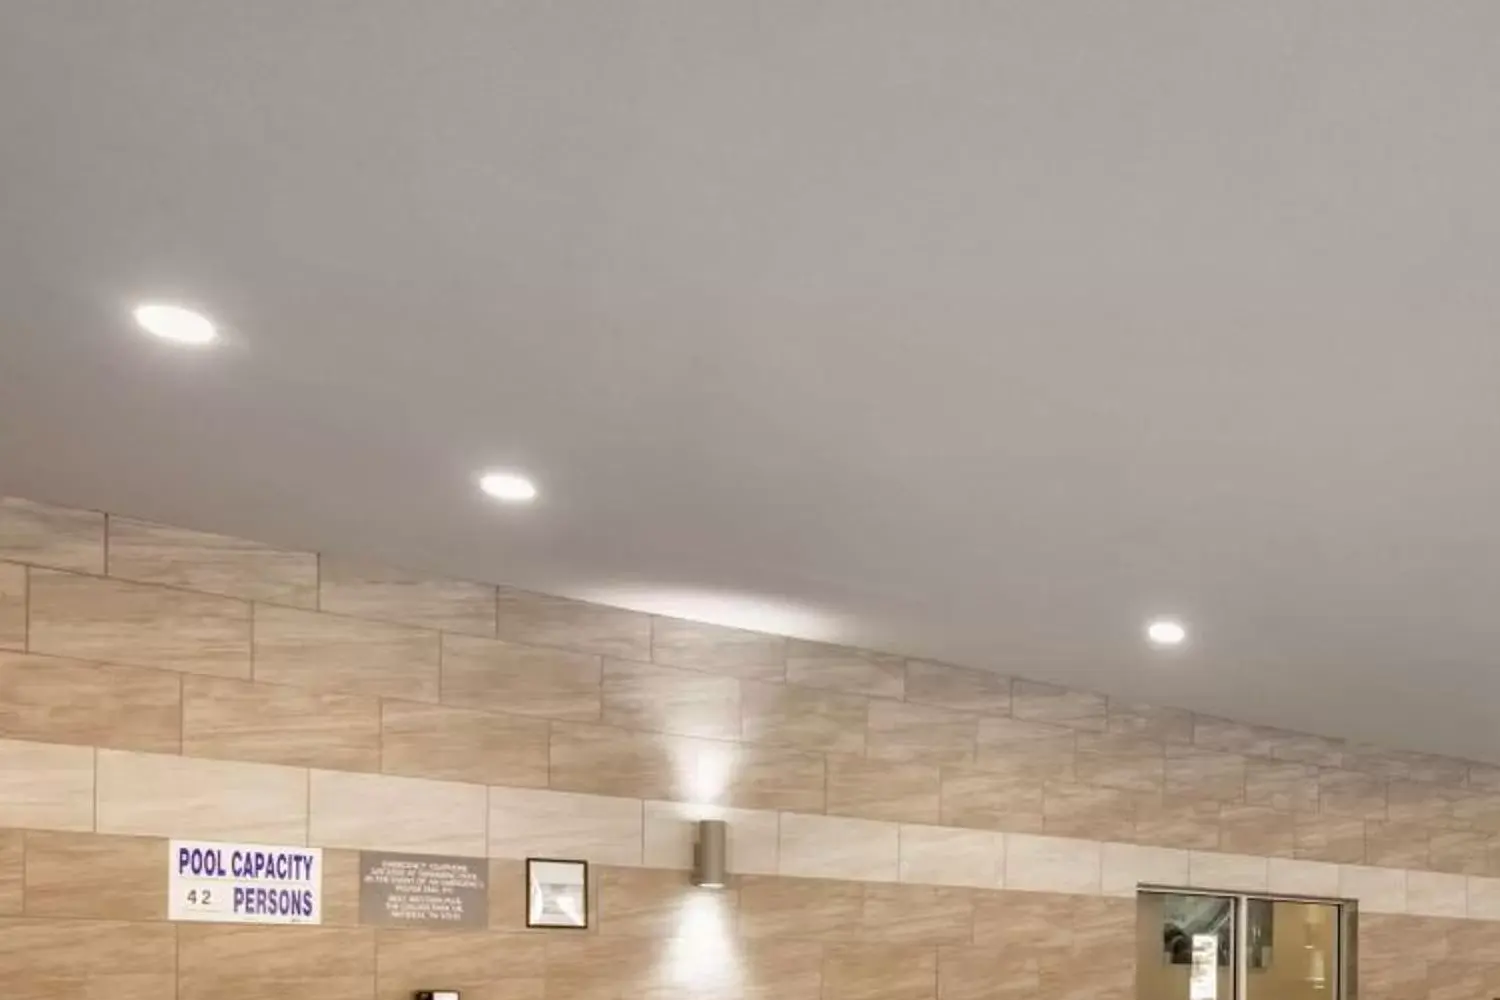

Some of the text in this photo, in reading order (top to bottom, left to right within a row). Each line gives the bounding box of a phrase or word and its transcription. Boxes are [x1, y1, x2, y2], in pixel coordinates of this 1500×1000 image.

[178, 847, 313, 881] POOL CAPACITY
[233, 886, 313, 917] PERSONS
